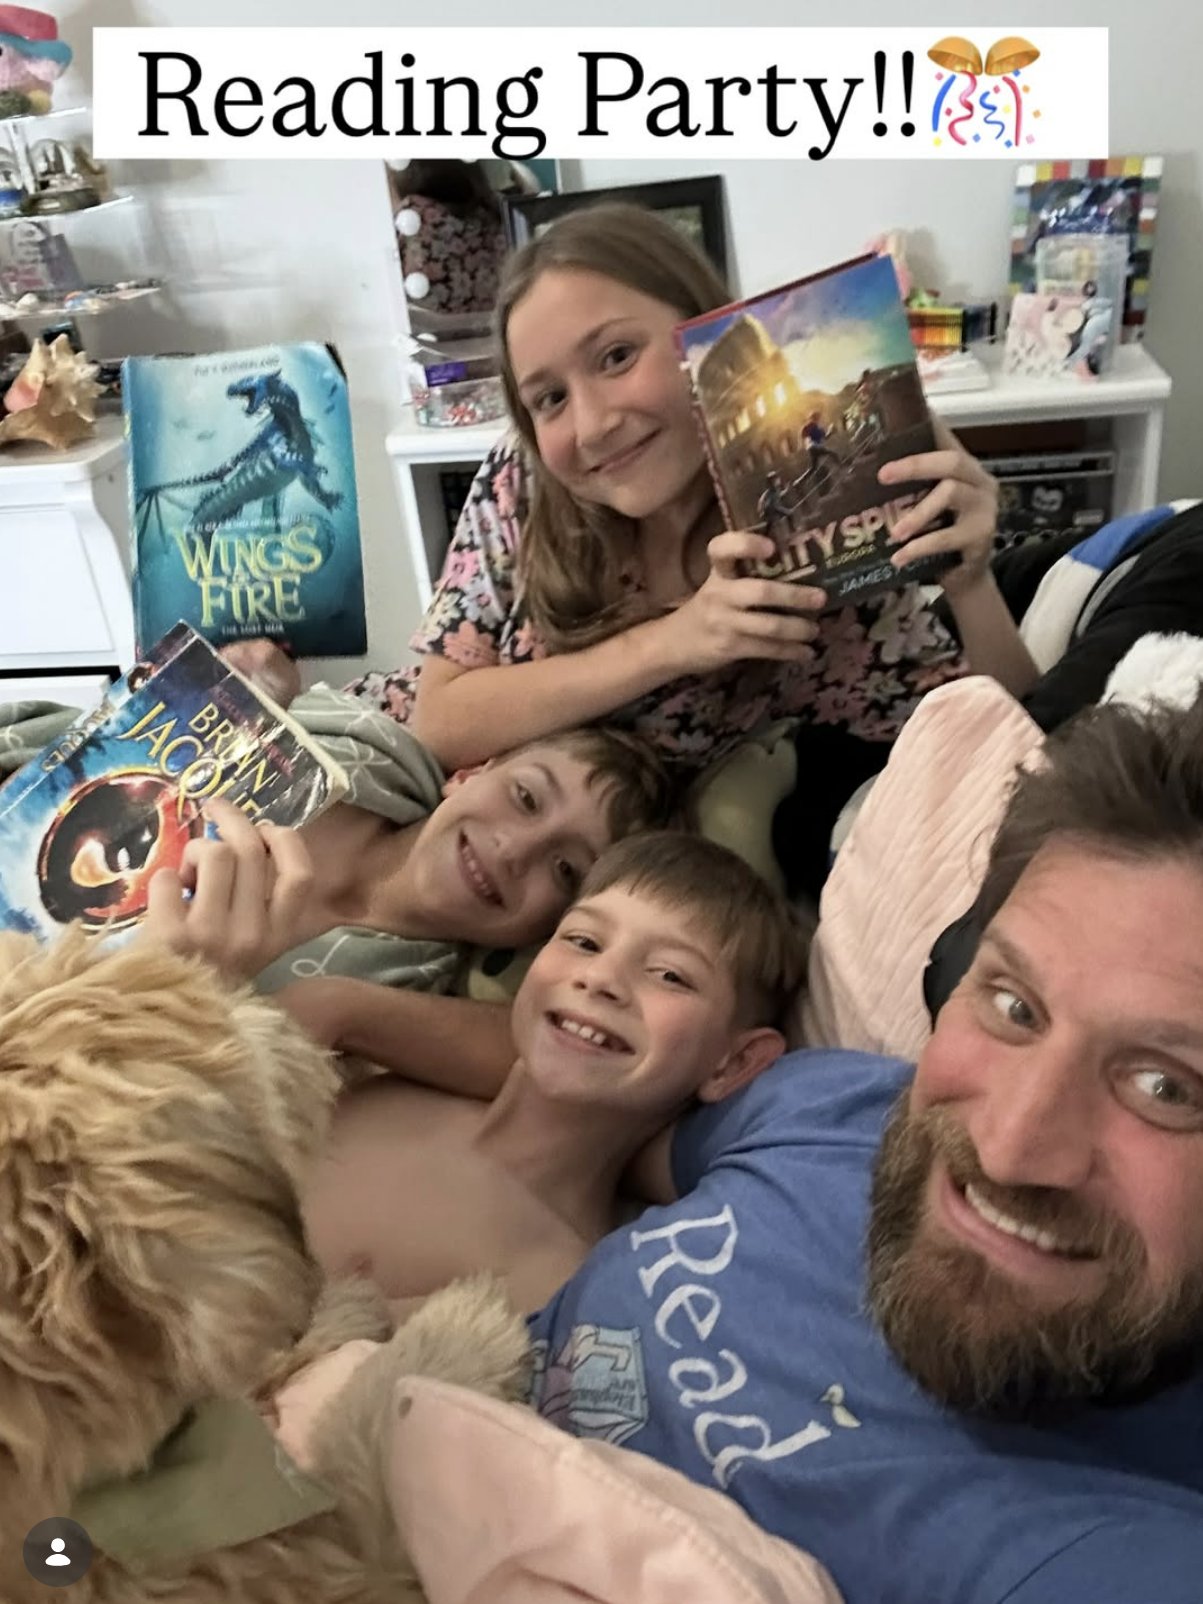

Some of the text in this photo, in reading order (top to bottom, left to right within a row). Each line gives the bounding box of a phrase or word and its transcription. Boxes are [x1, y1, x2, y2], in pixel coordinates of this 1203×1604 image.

[172, 524, 322, 581] WINGS
[198, 573, 305, 628] FIRE
[838, 566, 894, 598] JAMES
[188, 702, 275, 793] BRIAN
[630, 1203, 832, 1490] Read
